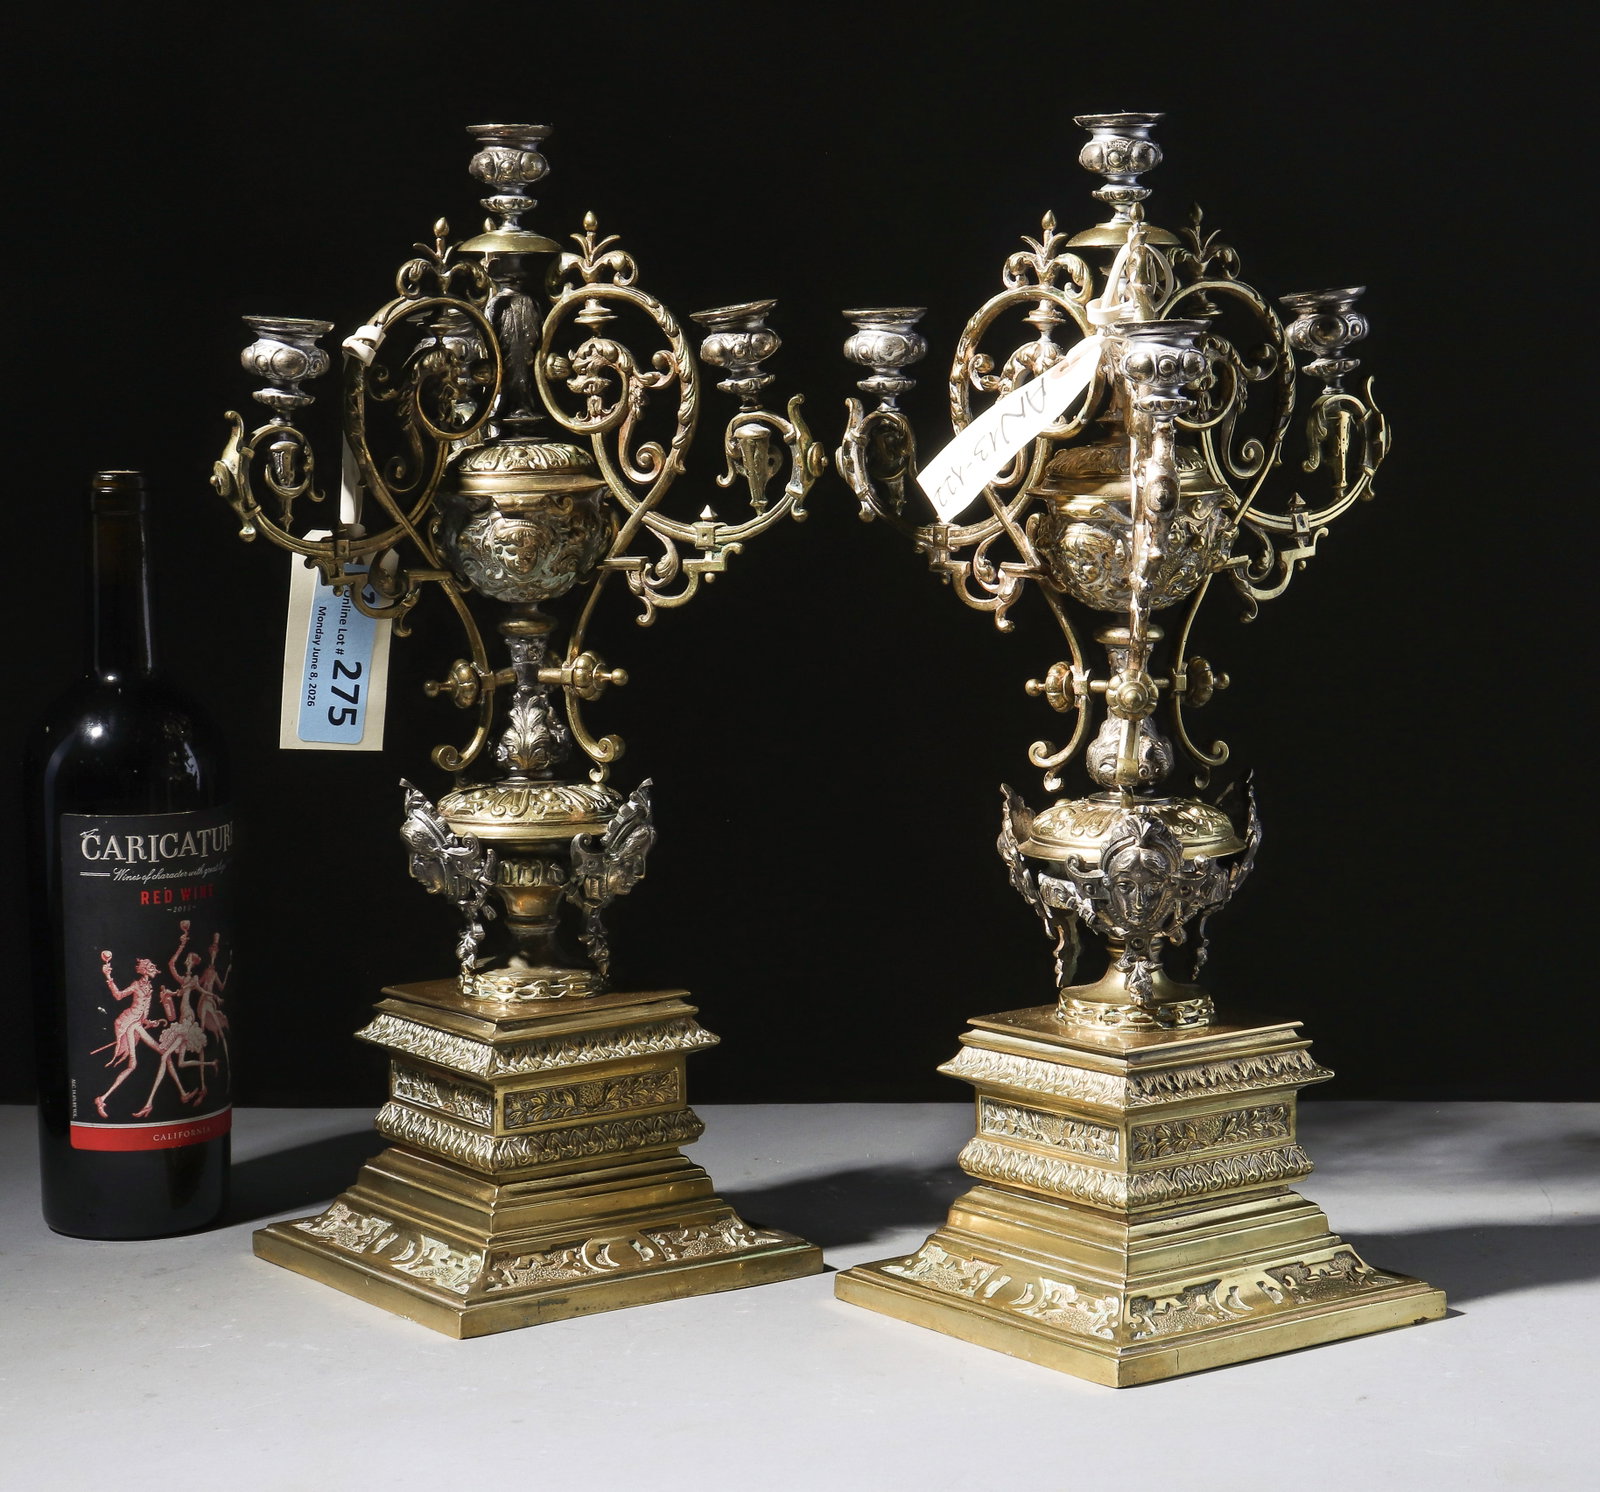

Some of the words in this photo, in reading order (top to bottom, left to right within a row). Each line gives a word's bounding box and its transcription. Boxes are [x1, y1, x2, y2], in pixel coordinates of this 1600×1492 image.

[313, 607, 327, 645] Monday
[336, 629, 347, 645] Lot
[310, 646, 322, 670] June
[308, 671, 319, 682] 8,
[307, 683, 317, 707] 2026
[327, 659, 362, 726] 275
[81, 821, 233, 864] CARICATUR
[112, 867, 142, 882] Wines
[142, 868, 155, 885] of
[152, 867, 188, 880] character
[140, 889, 174, 905] RED
[153, 1126, 212, 1142] CALIFORNIA
